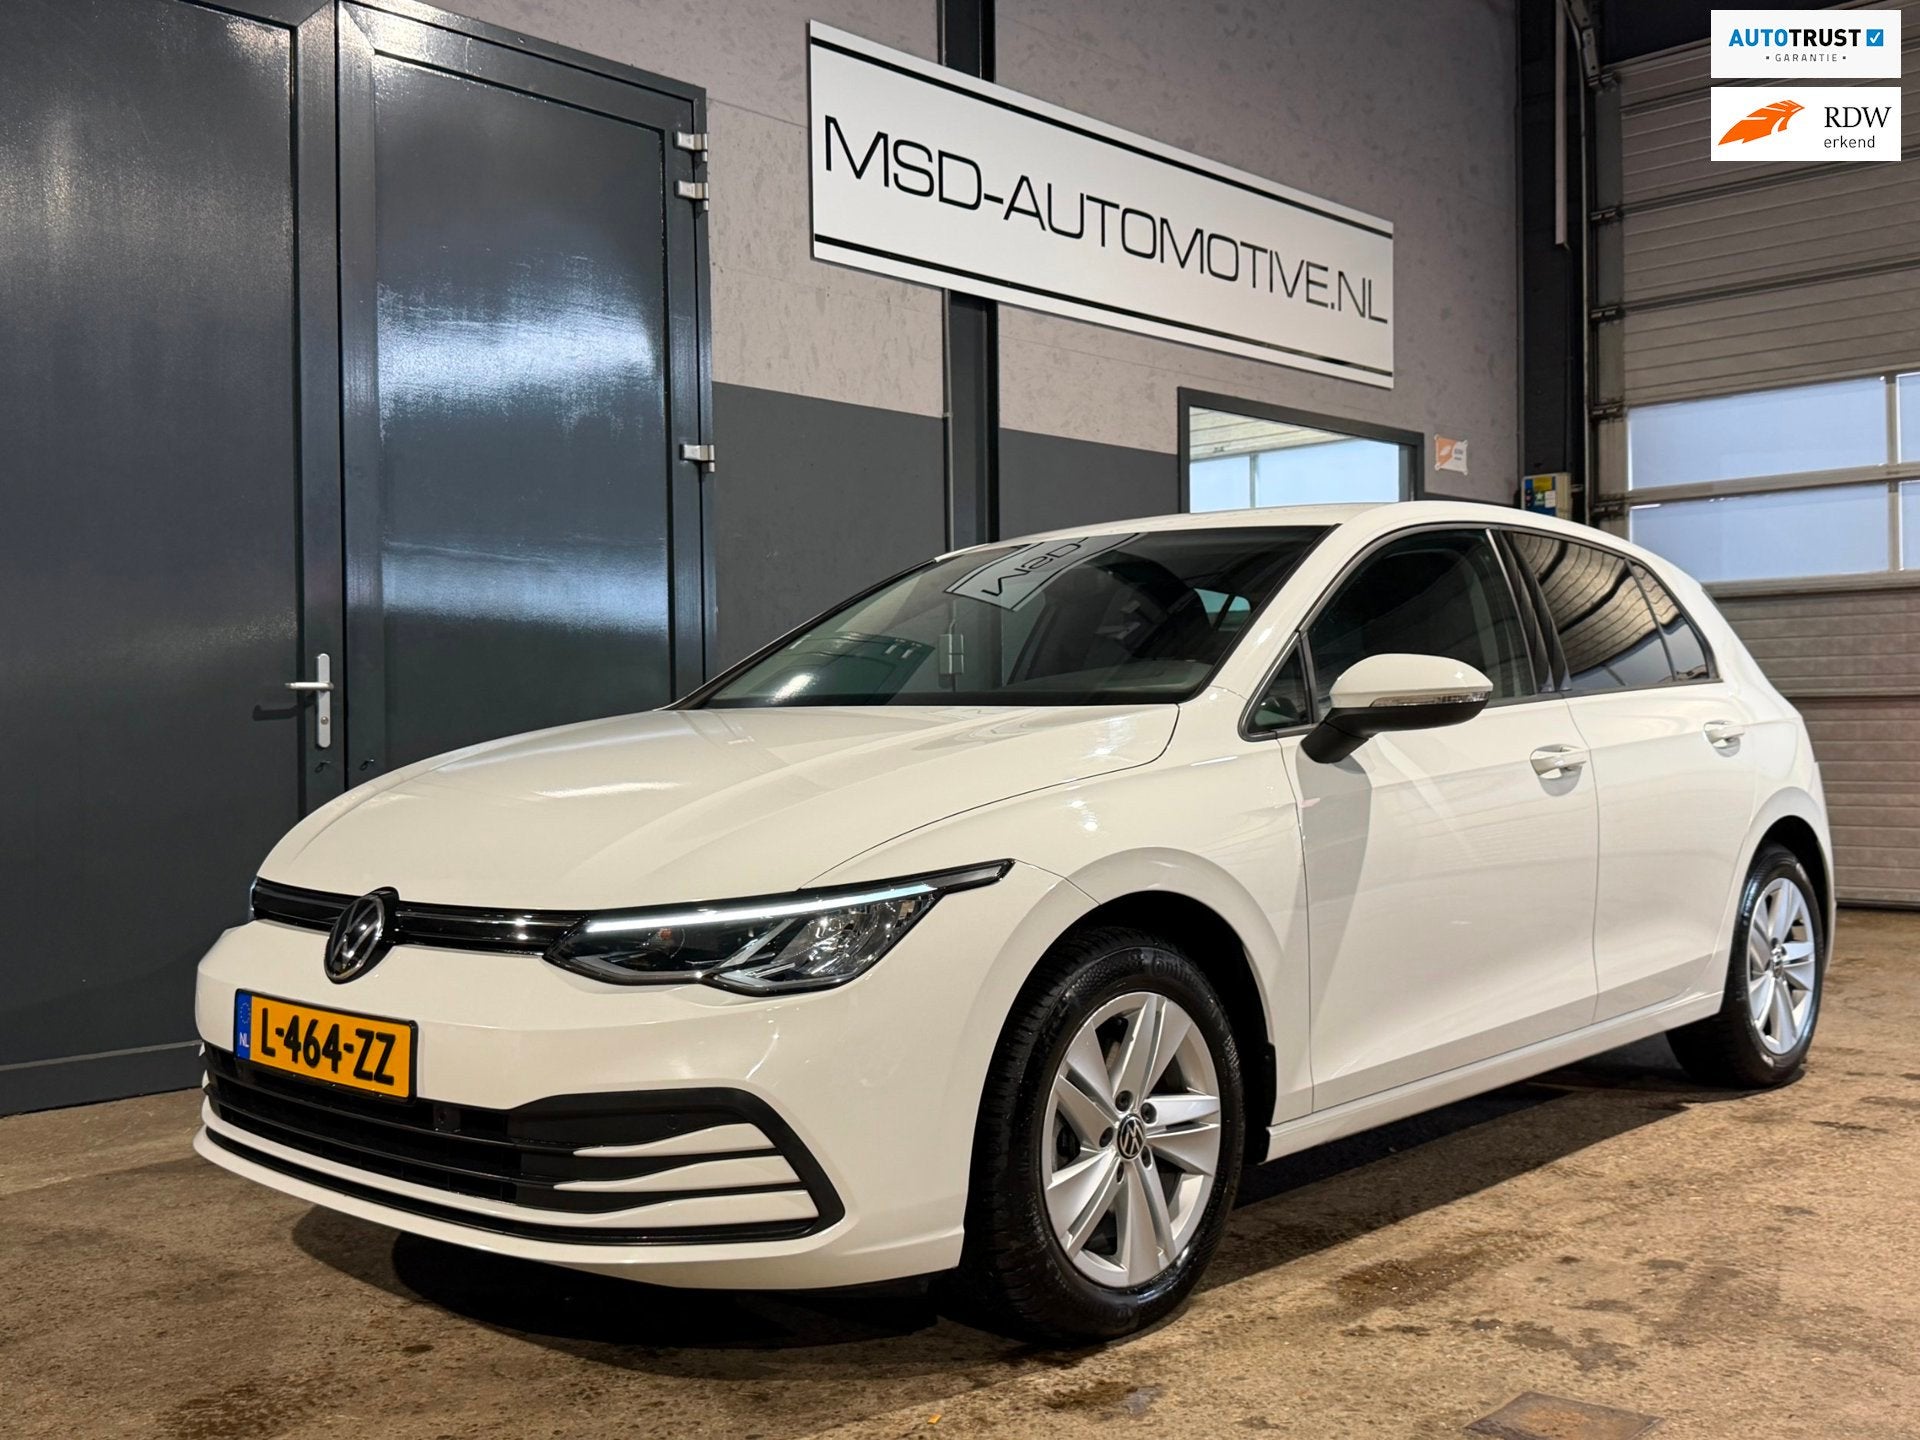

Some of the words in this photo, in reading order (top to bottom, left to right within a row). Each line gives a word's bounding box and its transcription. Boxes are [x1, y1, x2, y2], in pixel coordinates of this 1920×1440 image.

[824, 115, 1388, 324] MSD-AUTOMOTIVE.NL
[239, 1032, 249, 1048] NL
[261, 1008, 396, 1086] L-464-ZZ
